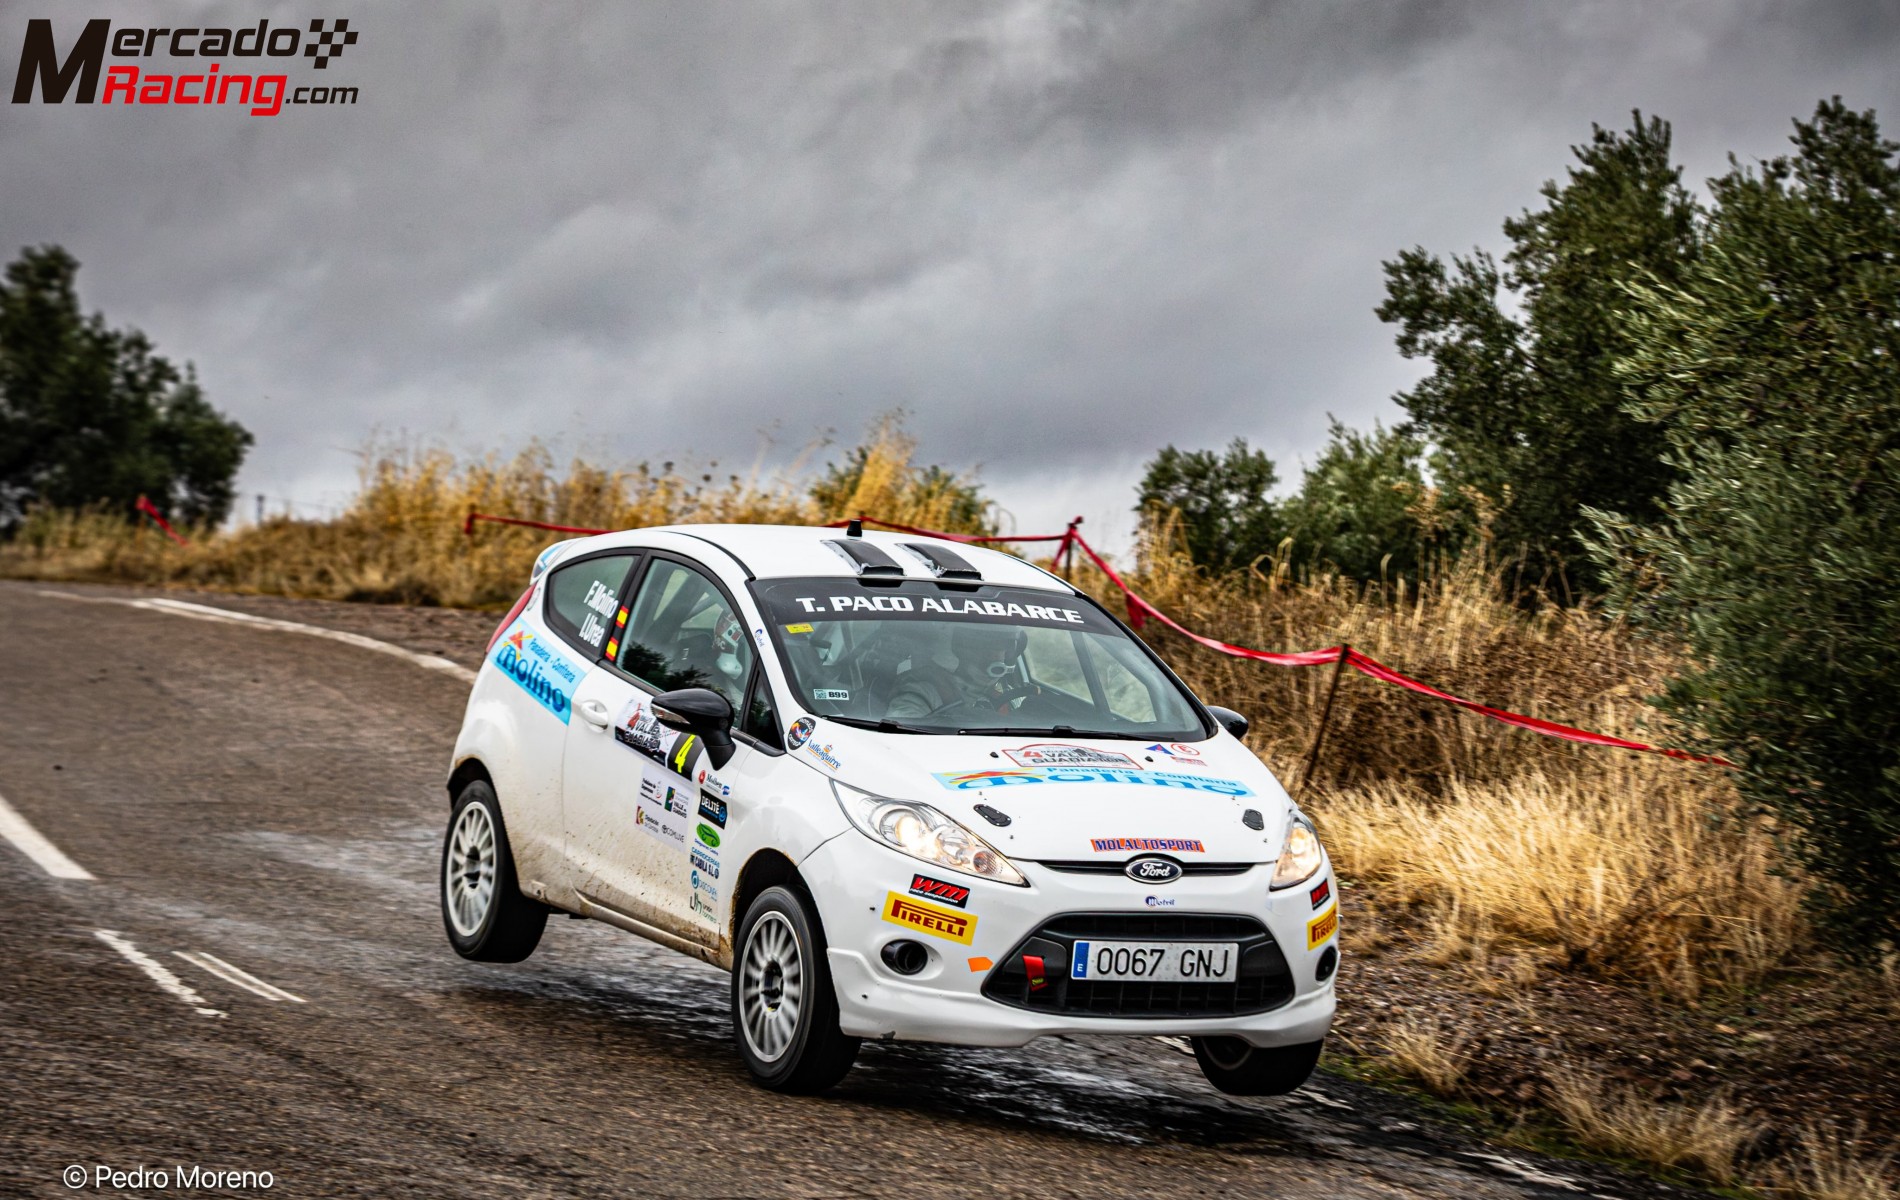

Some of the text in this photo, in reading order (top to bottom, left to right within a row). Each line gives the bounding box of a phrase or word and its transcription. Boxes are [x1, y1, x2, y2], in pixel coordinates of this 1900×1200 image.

[796, 596, 1085, 624] T. PACO ALABARCE
[496, 645, 566, 713] Molino
[828, 691, 848, 699] B99
[675, 733, 697, 774] 4
[957, 773, 1248, 796] Molino
[1094, 838, 1201, 851] MOLAUTOSPORT
[1140, 862, 1170, 877] Ford
[890, 898, 968, 937] PIRELLI
[1077, 947, 1229, 978] E 0067 GNJ
